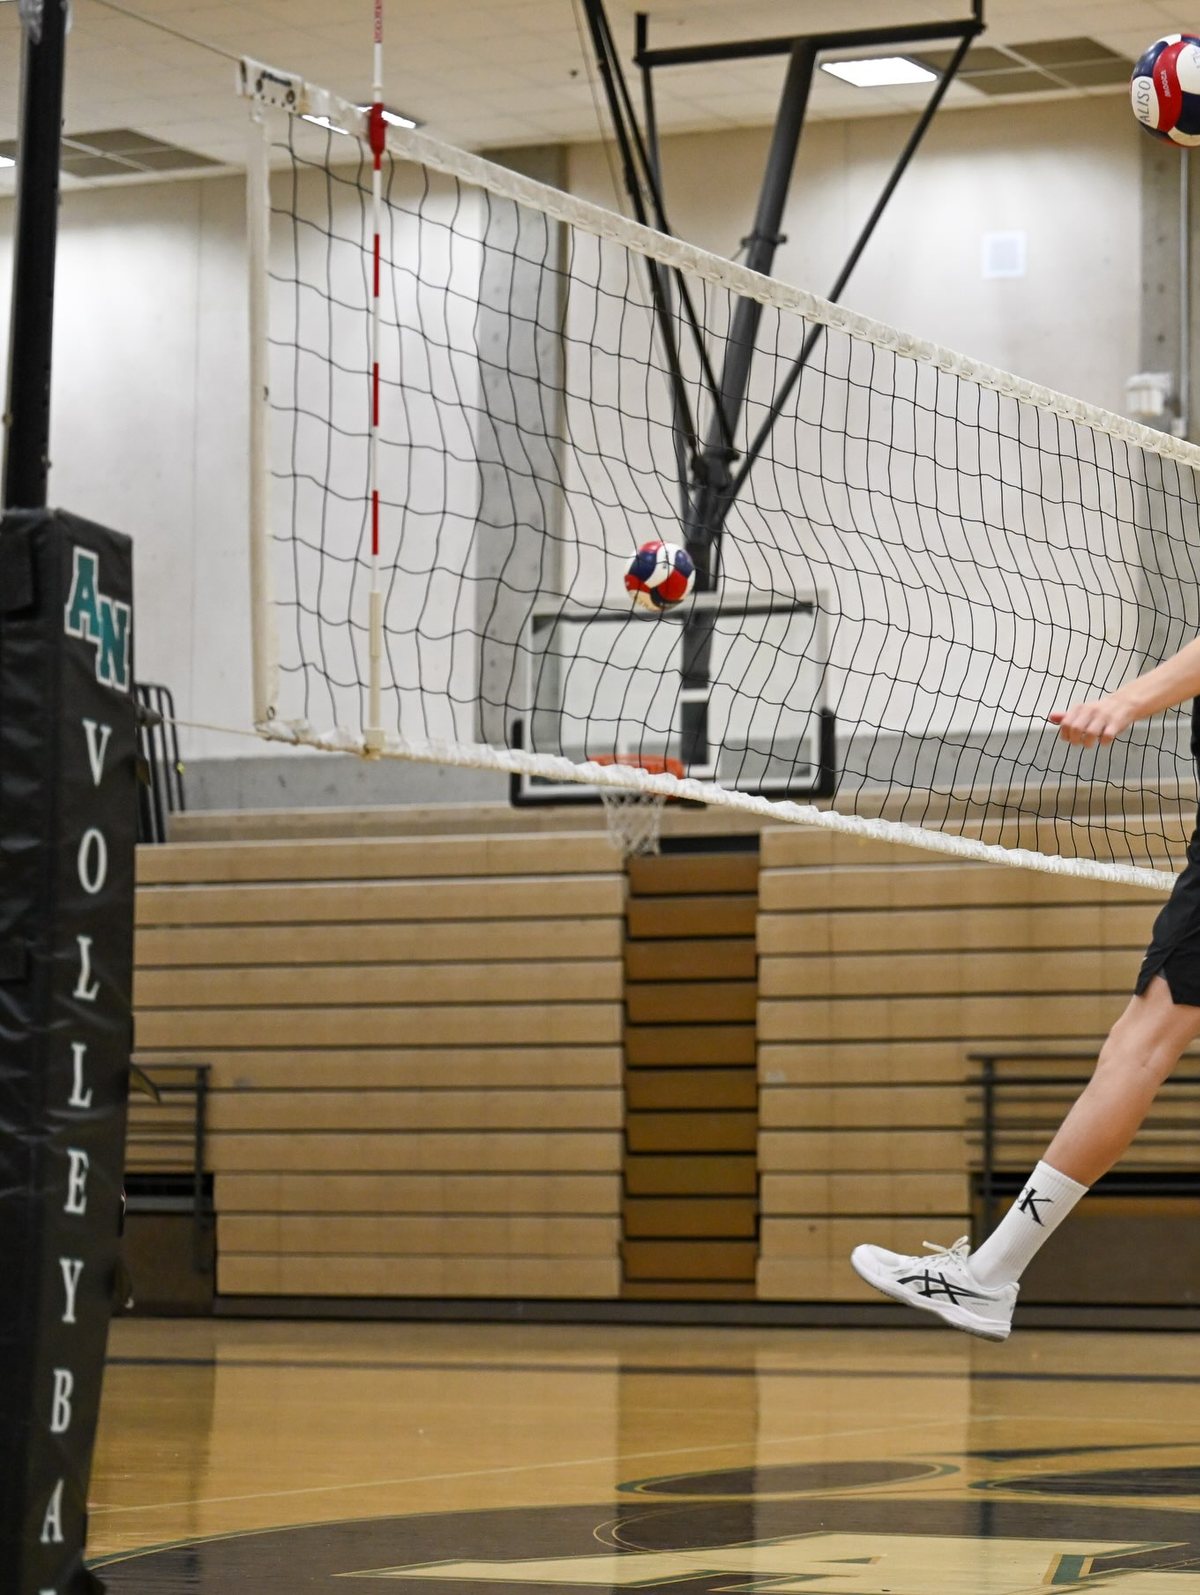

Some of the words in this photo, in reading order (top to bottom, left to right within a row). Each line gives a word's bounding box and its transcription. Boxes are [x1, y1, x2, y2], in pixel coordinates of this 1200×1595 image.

[1137, 80, 1151, 123] ALISO
[64, 547, 130, 693] AN
[38, 719, 112, 1595] VOLLEYBA
